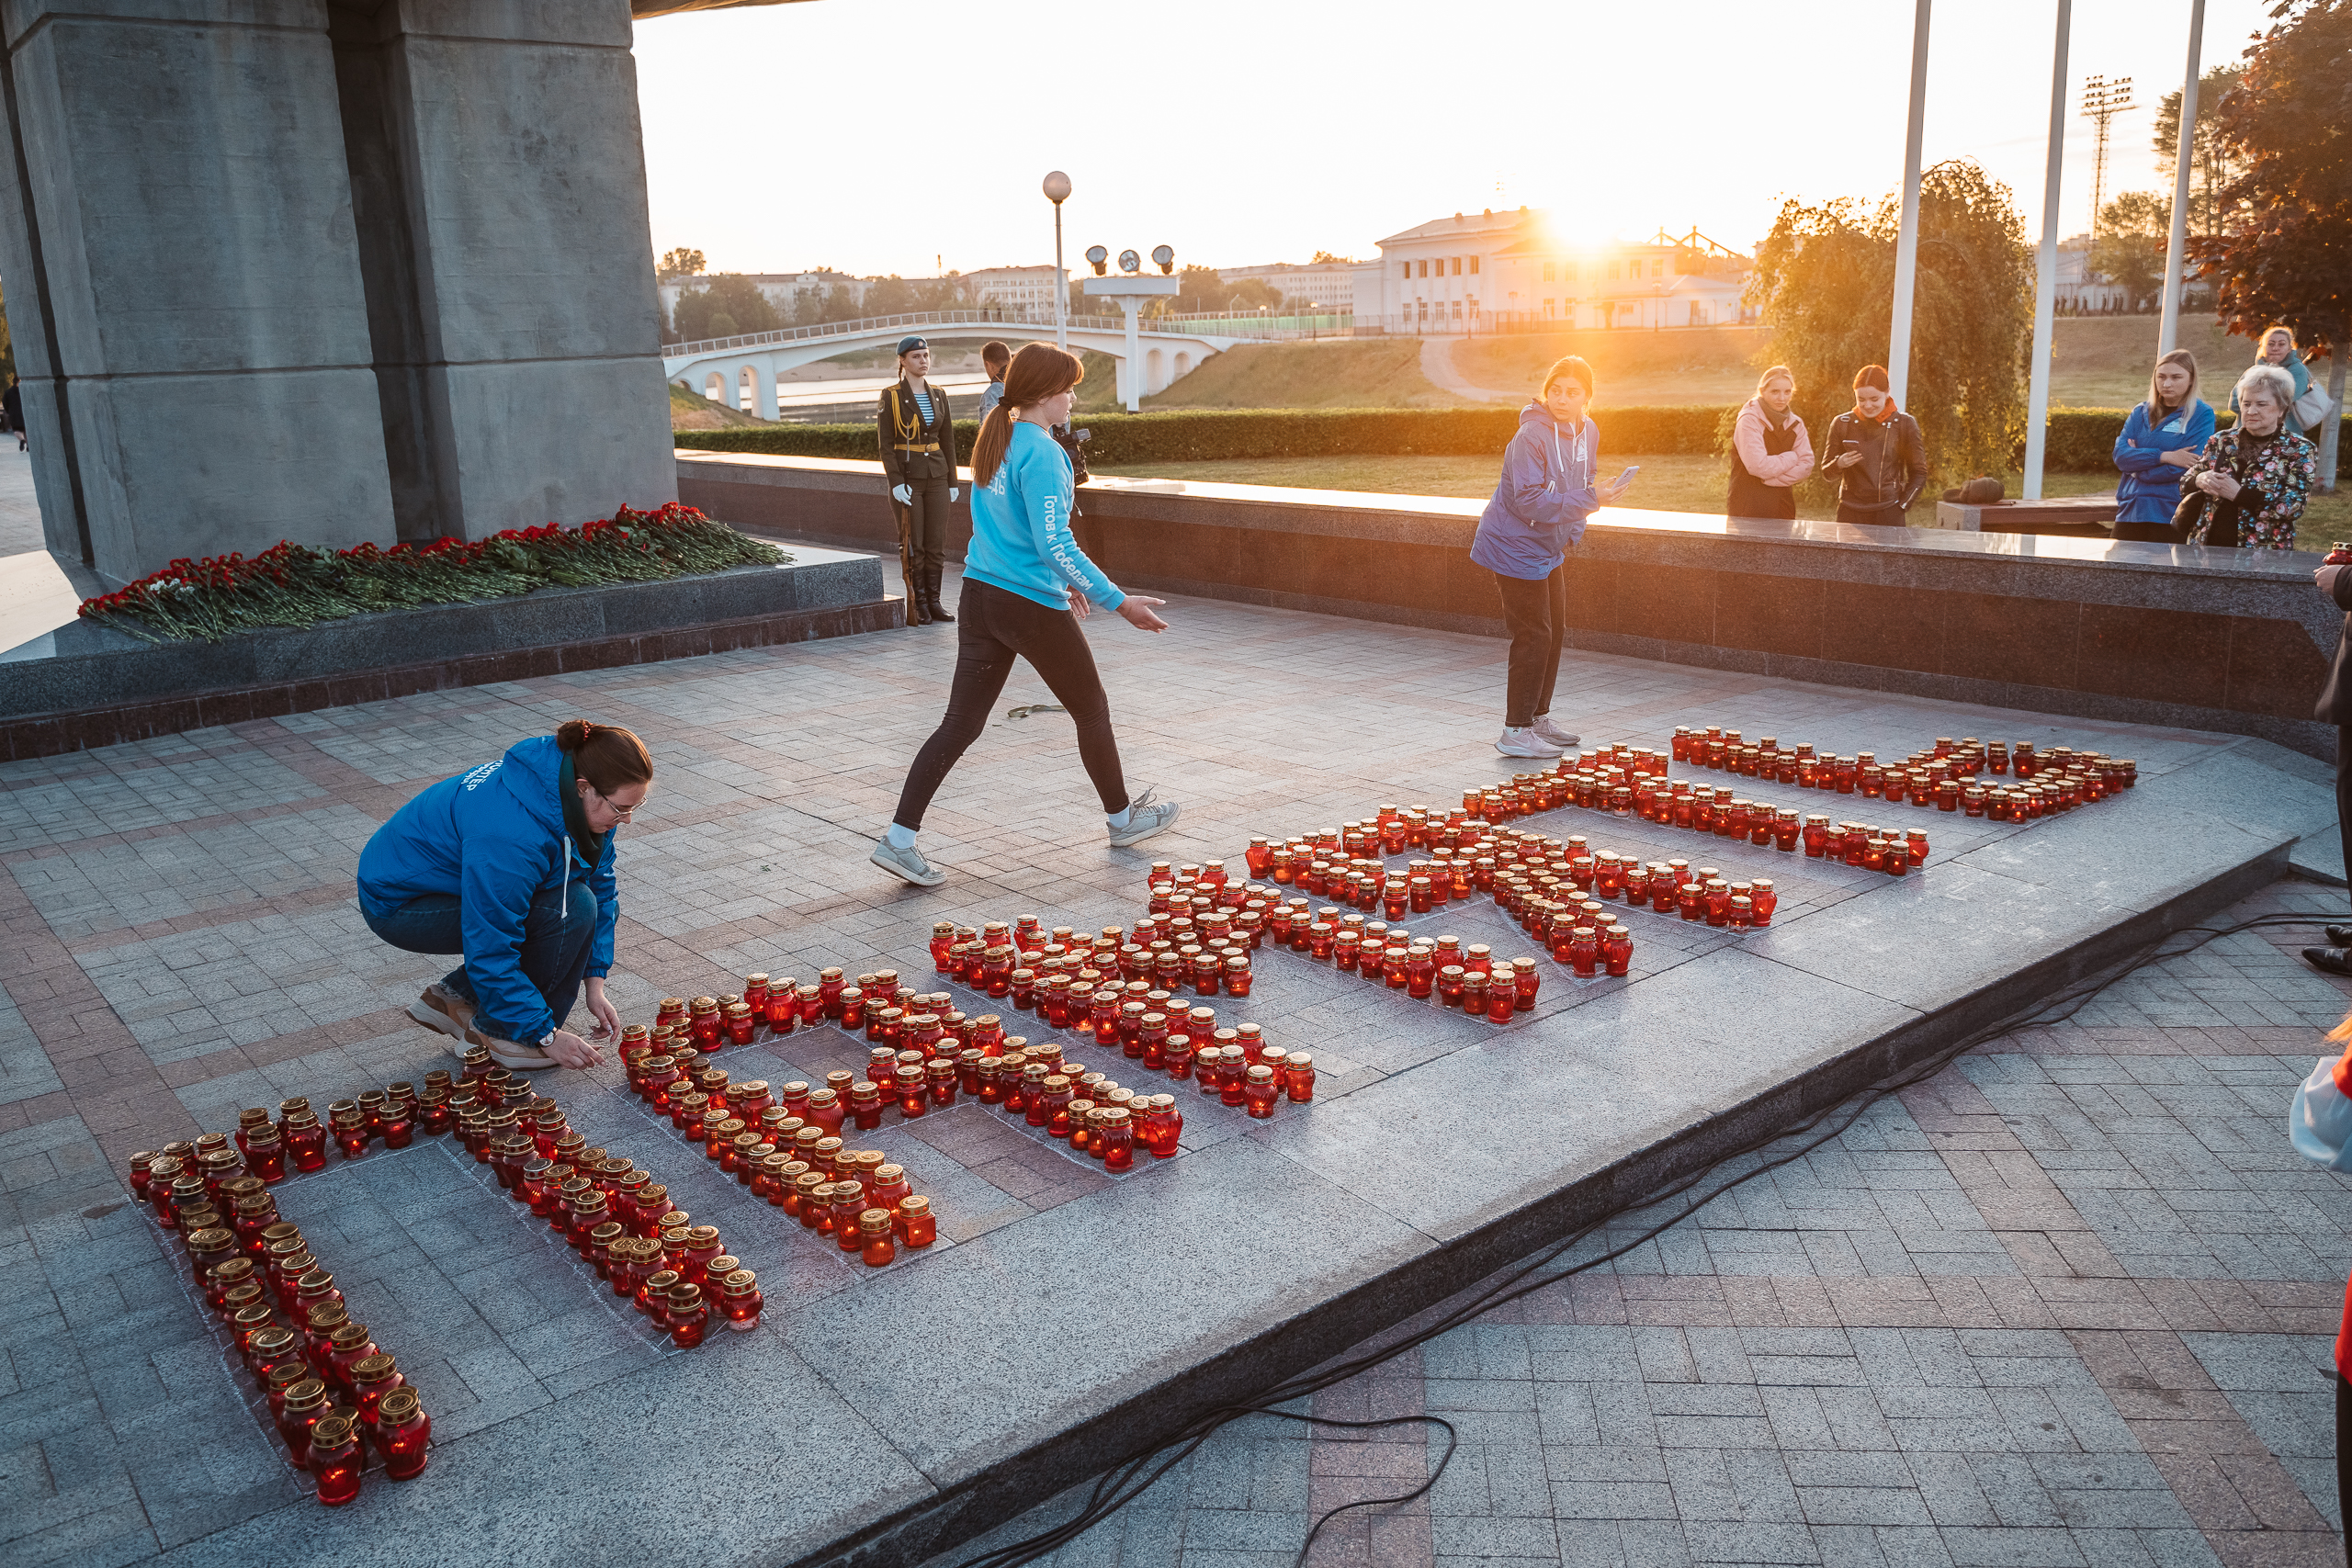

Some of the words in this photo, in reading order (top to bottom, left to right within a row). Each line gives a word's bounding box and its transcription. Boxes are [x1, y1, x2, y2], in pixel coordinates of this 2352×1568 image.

[1044, 495, 1057, 532] Готов
[1049, 543, 1094, 591] Победам
[129, 725, 2139, 1506] ПАМЯТЬ
